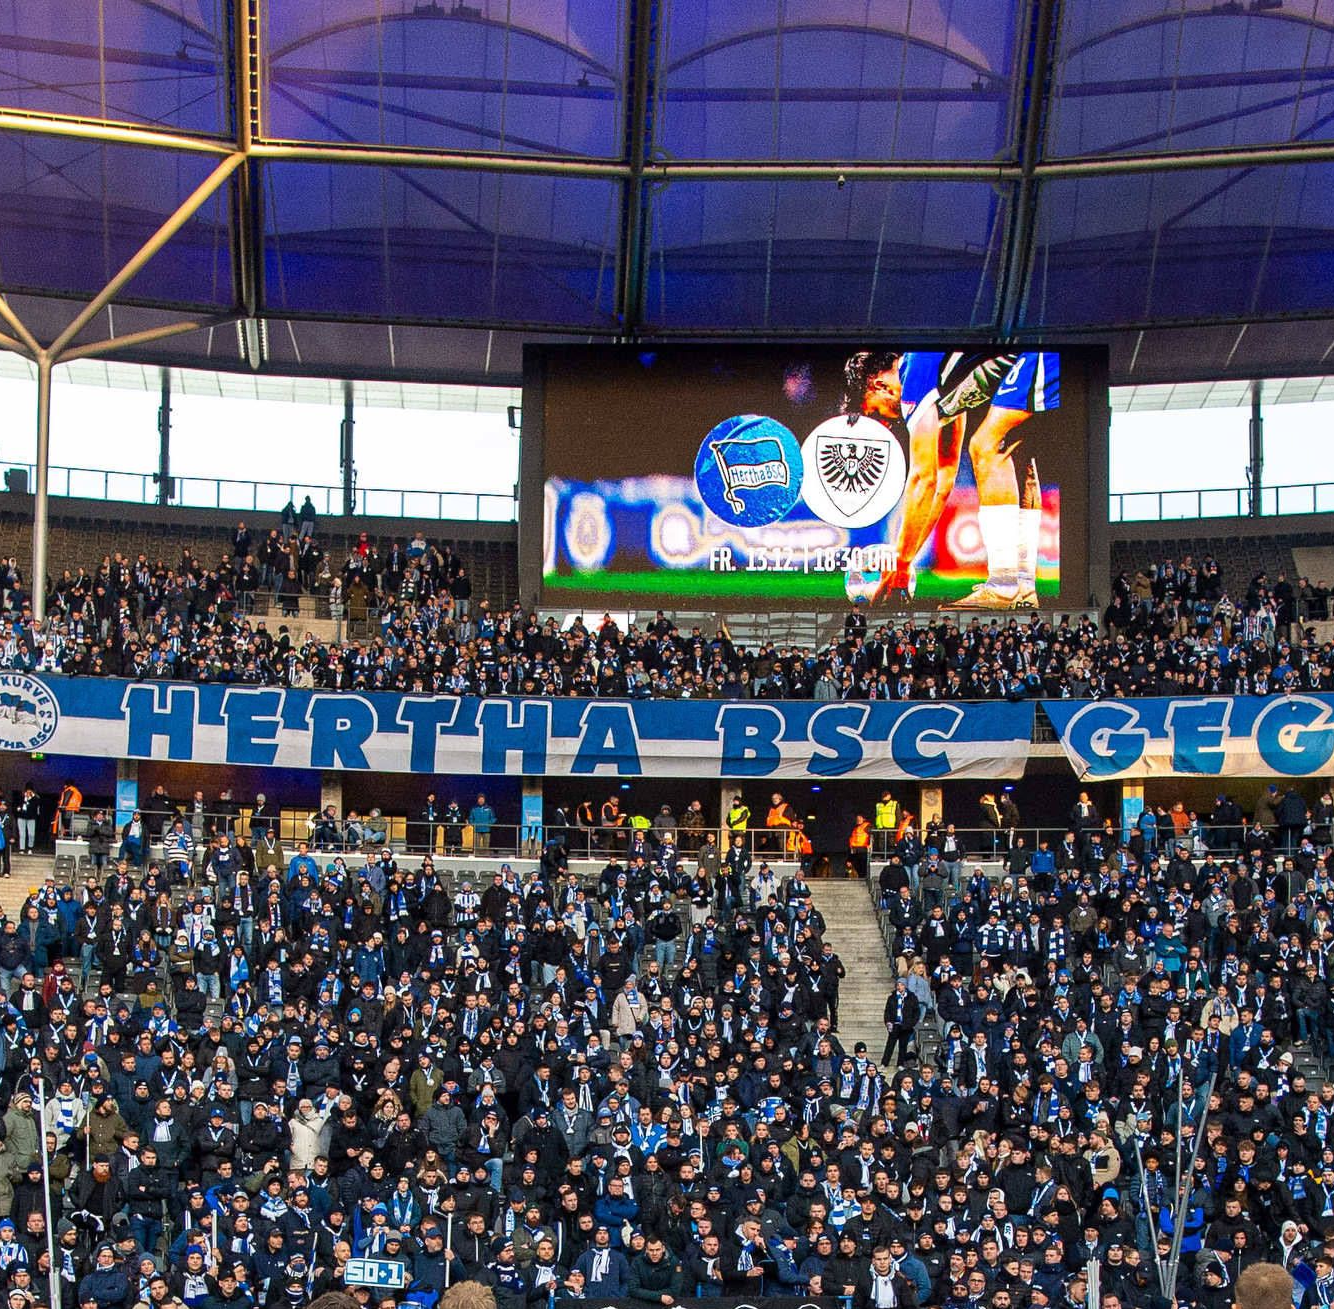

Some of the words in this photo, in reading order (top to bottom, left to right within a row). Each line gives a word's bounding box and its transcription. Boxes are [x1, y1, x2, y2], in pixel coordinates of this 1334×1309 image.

[709, 547, 736, 572] FR.
[745, 547, 799, 572] 13.12.
[813, 547, 865, 572] 18:30
[868, 547, 899, 572] Uhr
[38, 710, 53, 719] 92
[28, 722, 53, 747] BSC
[123, 685, 641, 775] HERTHA
[717, 702, 963, 779] BSC
